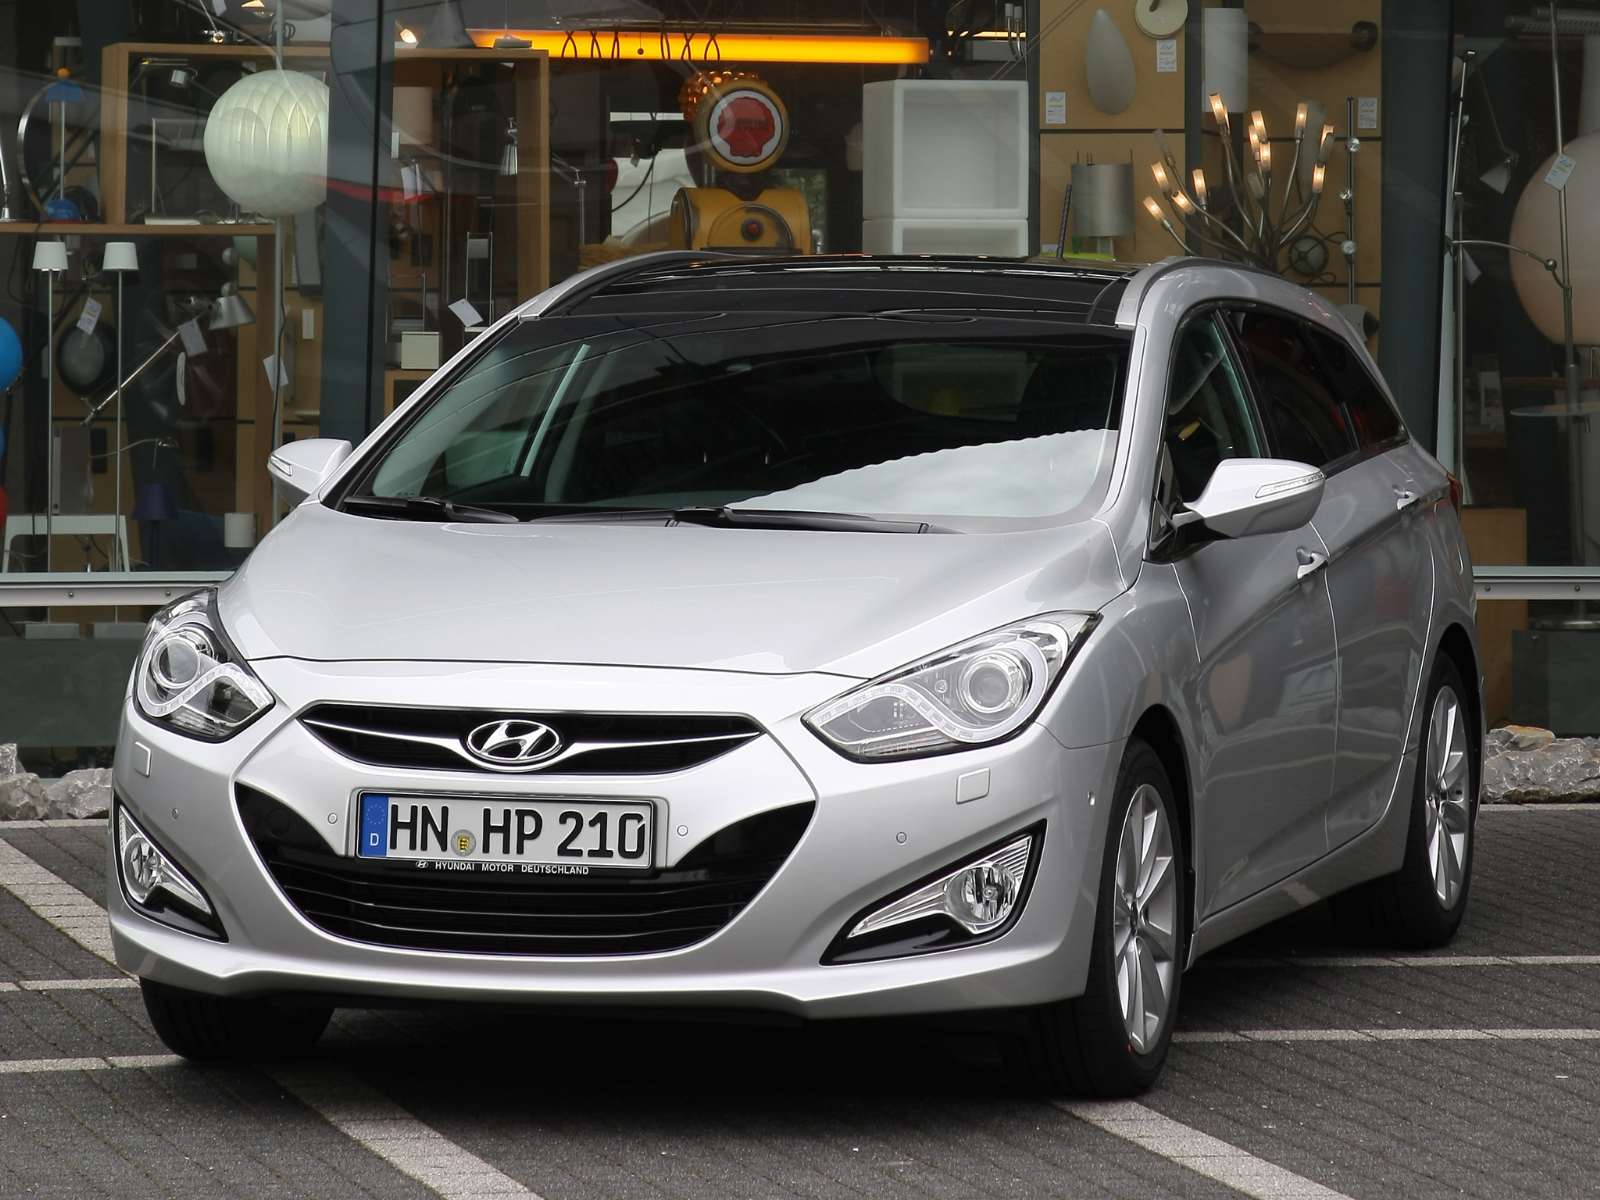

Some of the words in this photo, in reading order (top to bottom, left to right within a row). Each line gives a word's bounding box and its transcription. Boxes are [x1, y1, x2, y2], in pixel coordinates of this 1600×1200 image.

[390, 804, 449, 852] HN
[482, 808, 543, 854] HP
[557, 811, 646, 859] 210
[370, 833, 380, 846] D
[435, 862, 475, 871] HYUNDAI
[481, 863, 514, 872] MOTOR
[521, 864, 589, 875] DEUTSCHLAND
